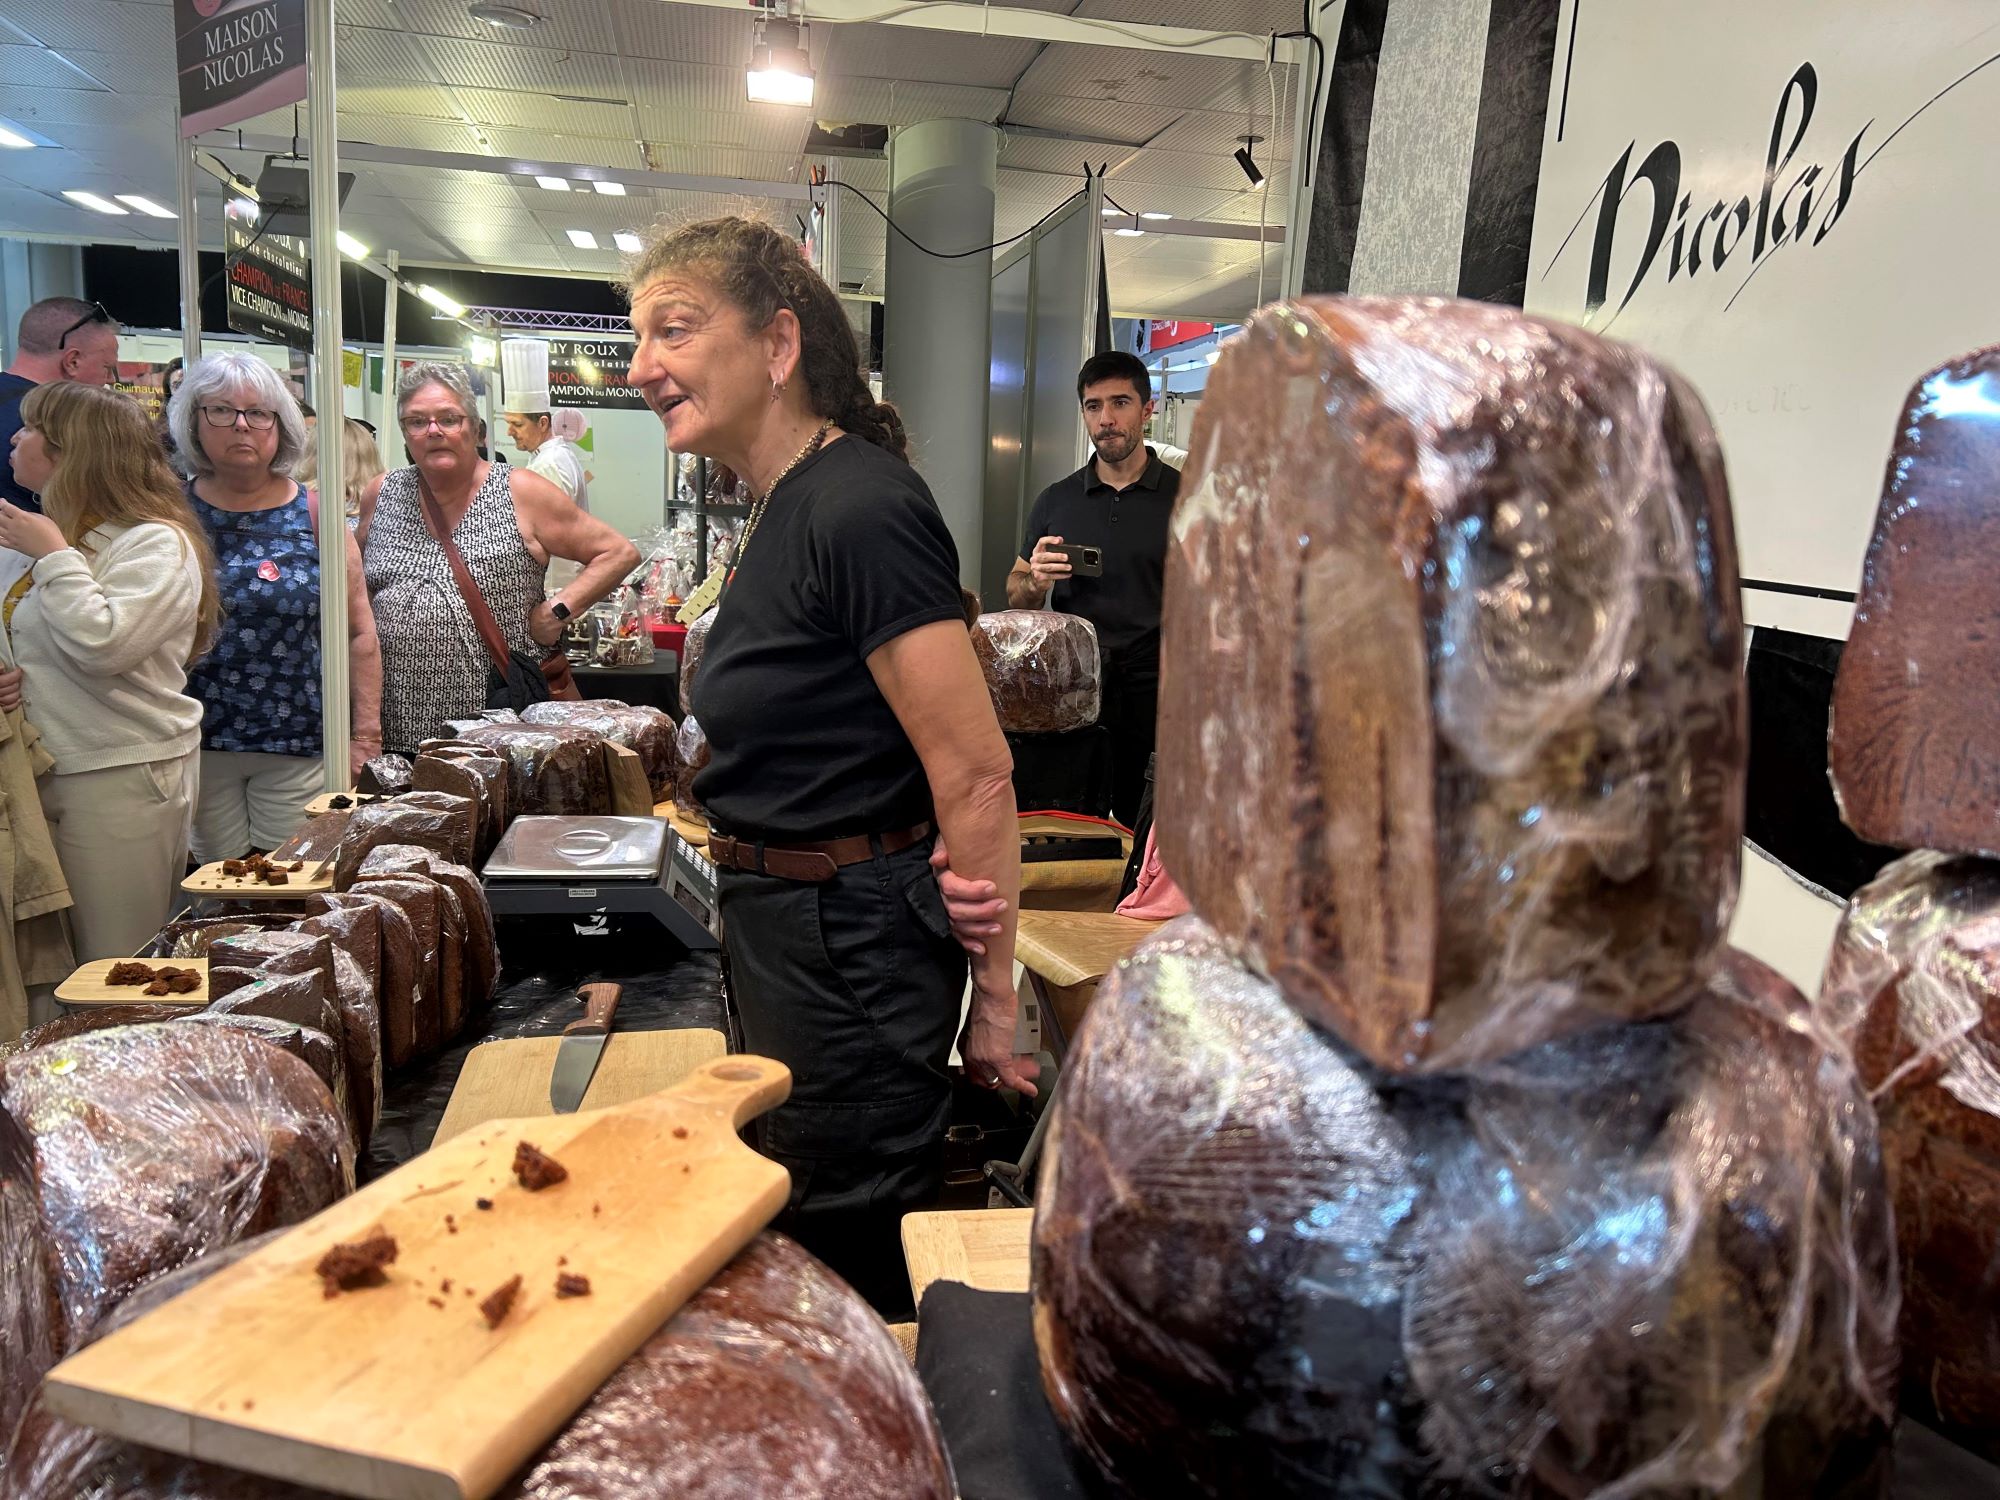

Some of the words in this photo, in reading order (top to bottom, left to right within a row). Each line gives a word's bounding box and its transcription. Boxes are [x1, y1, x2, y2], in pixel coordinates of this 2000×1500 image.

[204, 4, 278, 57] MAISON
[203, 36, 284, 91] NICOLAS
[231, 260, 274, 297] CHAMPION
[231, 283, 247, 307] VICE
[248, 291, 281, 320] CHAMPION
[287, 308, 310, 331] MONDE
[548, 342, 567, 354] UY
[573, 343, 619, 357] ROUX
[548, 371, 580, 385] PION
[549, 385, 594, 397] AMPION
